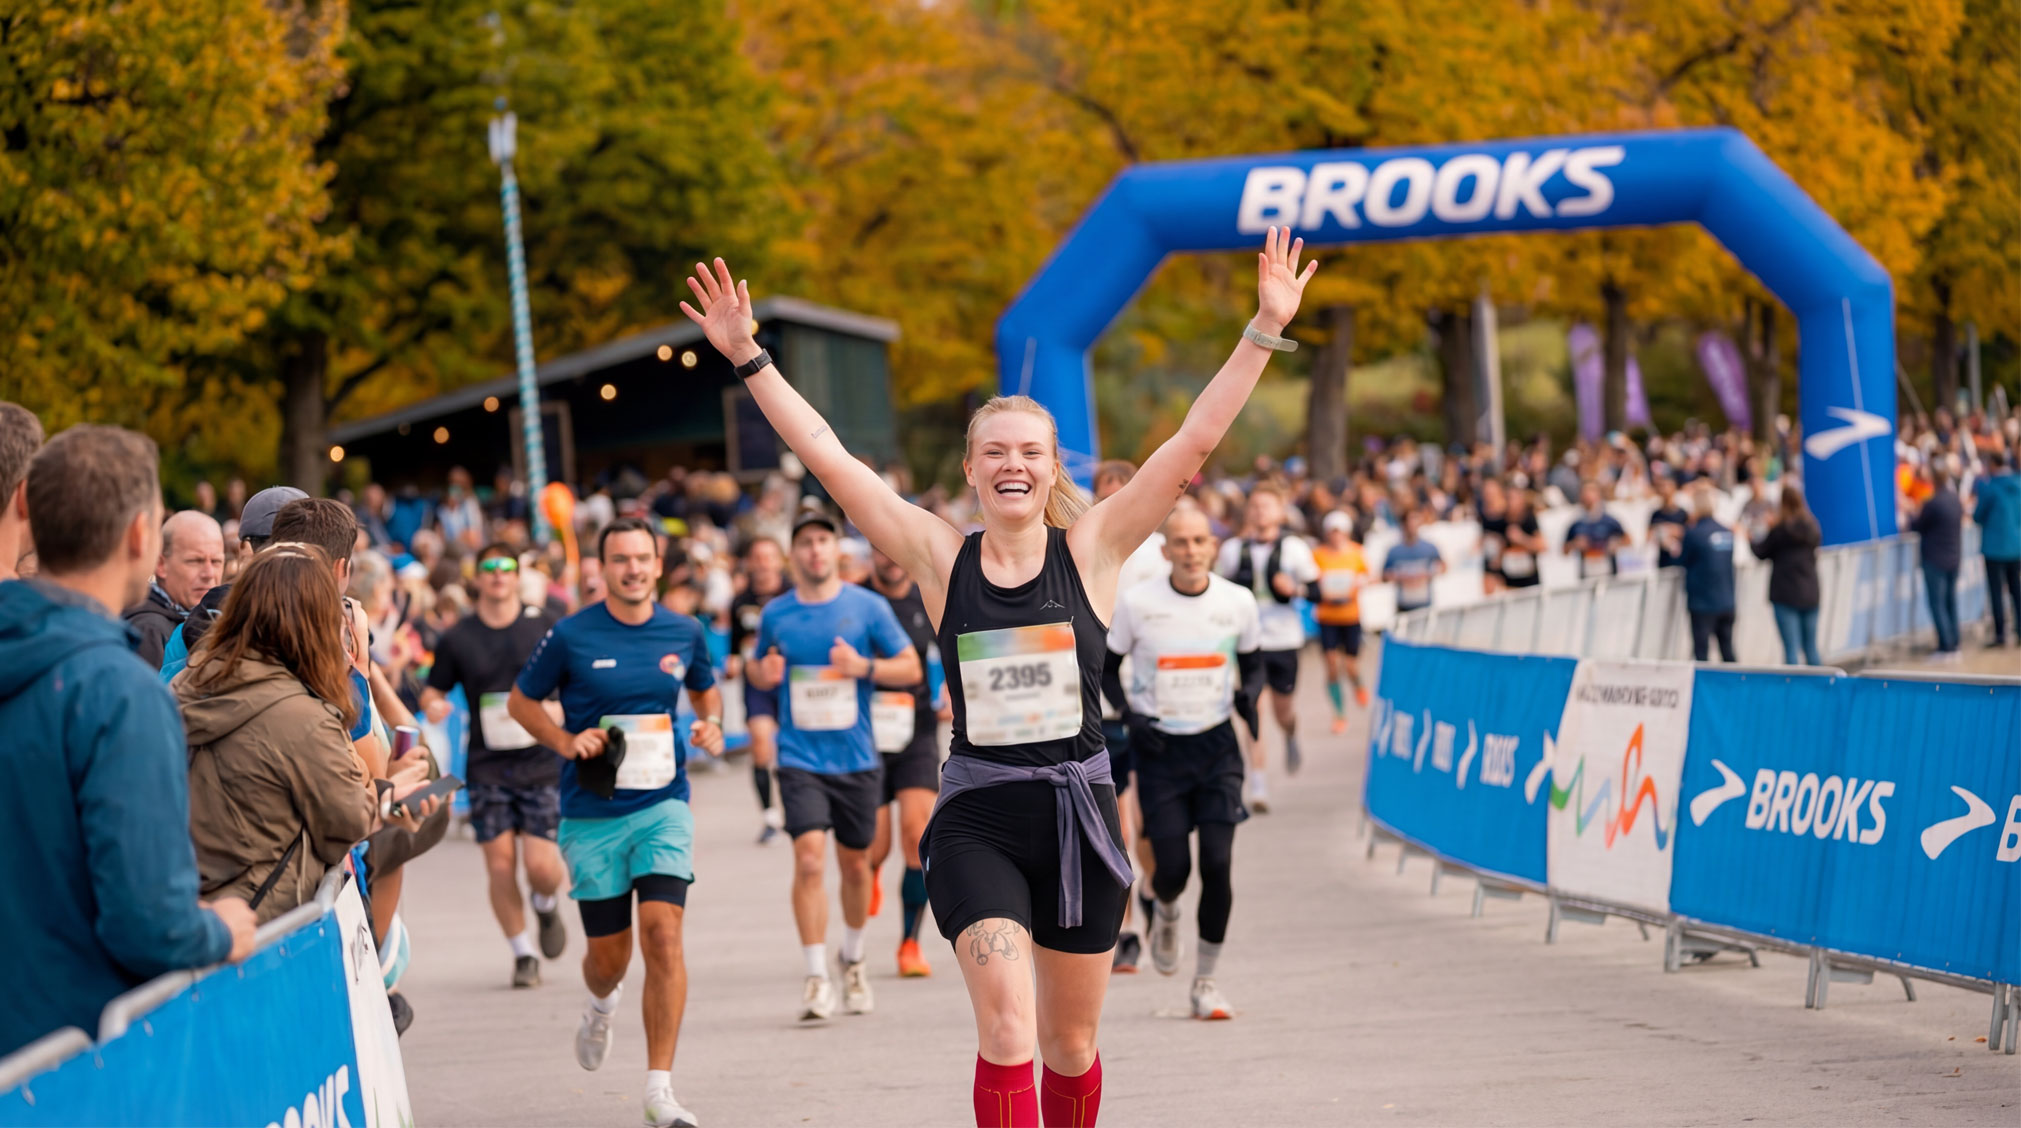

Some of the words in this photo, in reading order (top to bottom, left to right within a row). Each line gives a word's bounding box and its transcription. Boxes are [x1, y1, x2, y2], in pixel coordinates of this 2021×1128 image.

[1238, 146, 1625, 235] BROOKS
[989, 662, 1053, 691] 2395
[1745, 768, 1895, 845] BROOKS
